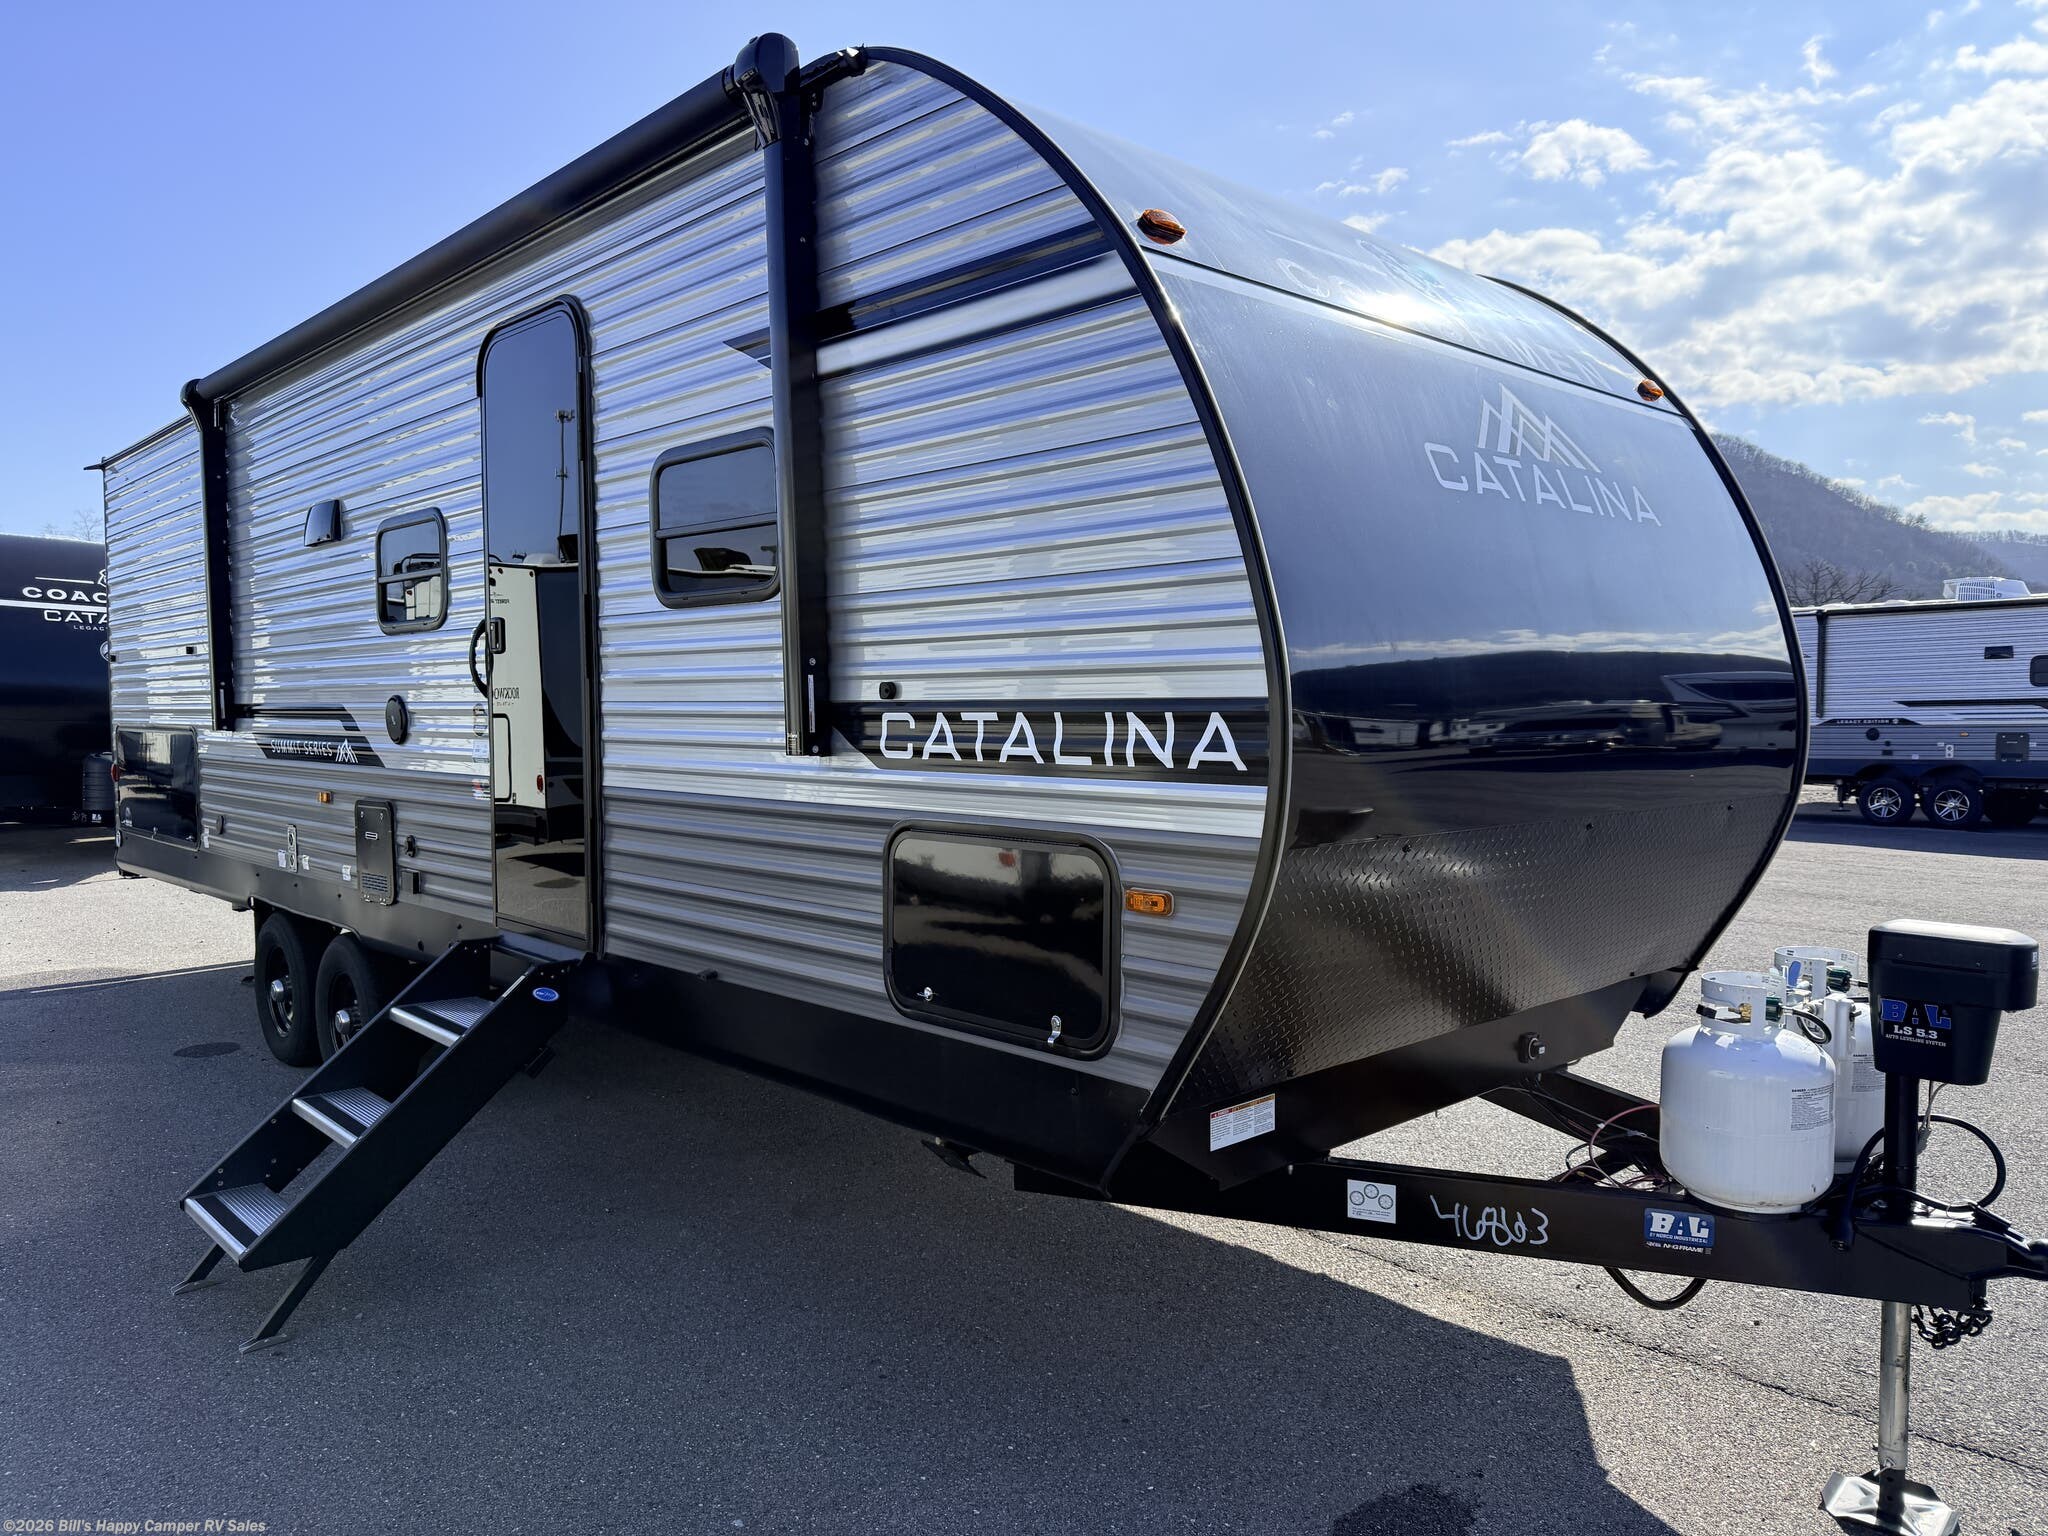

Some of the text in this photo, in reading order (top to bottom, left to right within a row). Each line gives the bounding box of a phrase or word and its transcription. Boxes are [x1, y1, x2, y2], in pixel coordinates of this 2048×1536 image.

[1424, 442, 1661, 527] CATALINA
[270, 739, 333, 757] SUMMIT SERIES
[880, 712, 1248, 771] CATALINA
[1880, 998, 1951, 1030] BAL
[1893, 1025, 1938, 1039] LS 5.3
[1650, 1212, 1709, 1238] BAL
